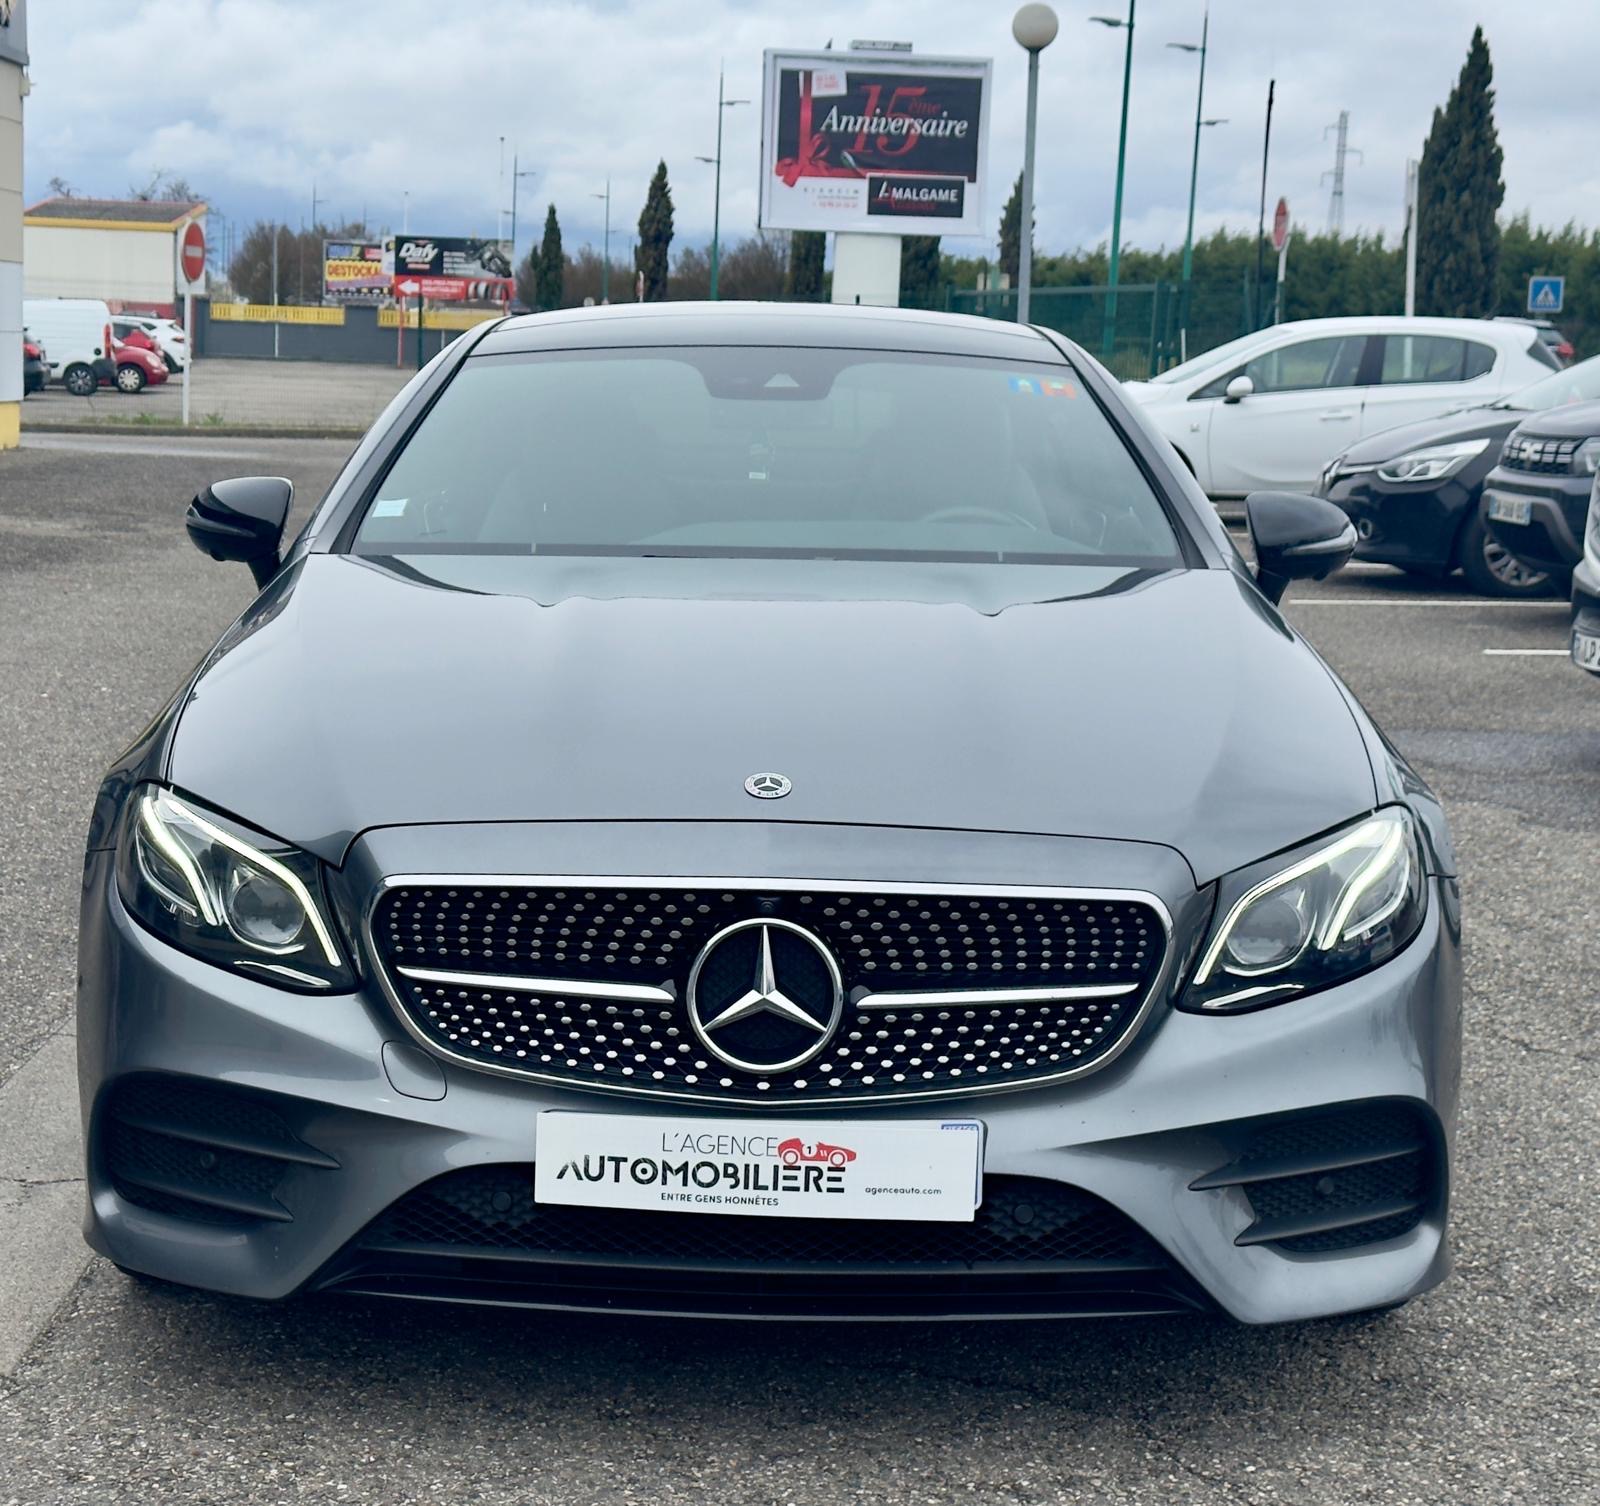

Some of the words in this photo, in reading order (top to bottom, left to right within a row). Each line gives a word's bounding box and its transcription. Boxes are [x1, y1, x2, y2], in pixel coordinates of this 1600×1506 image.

[821, 104, 969, 138] Anniversaire
[878, 180, 959, 203] AMALGAME
[398, 242, 439, 262] Dafy
[661, 1132, 779, 1157] L'AGENCE
[556, 1154, 846, 1194] AUTOMOBILIERE
[661, 1192, 692, 1202] ENTRE
[694, 1194, 722, 1204] GENS
[725, 1194, 779, 1206] HONNÊTES
[864, 1186, 942, 1195] agenceauto.com
